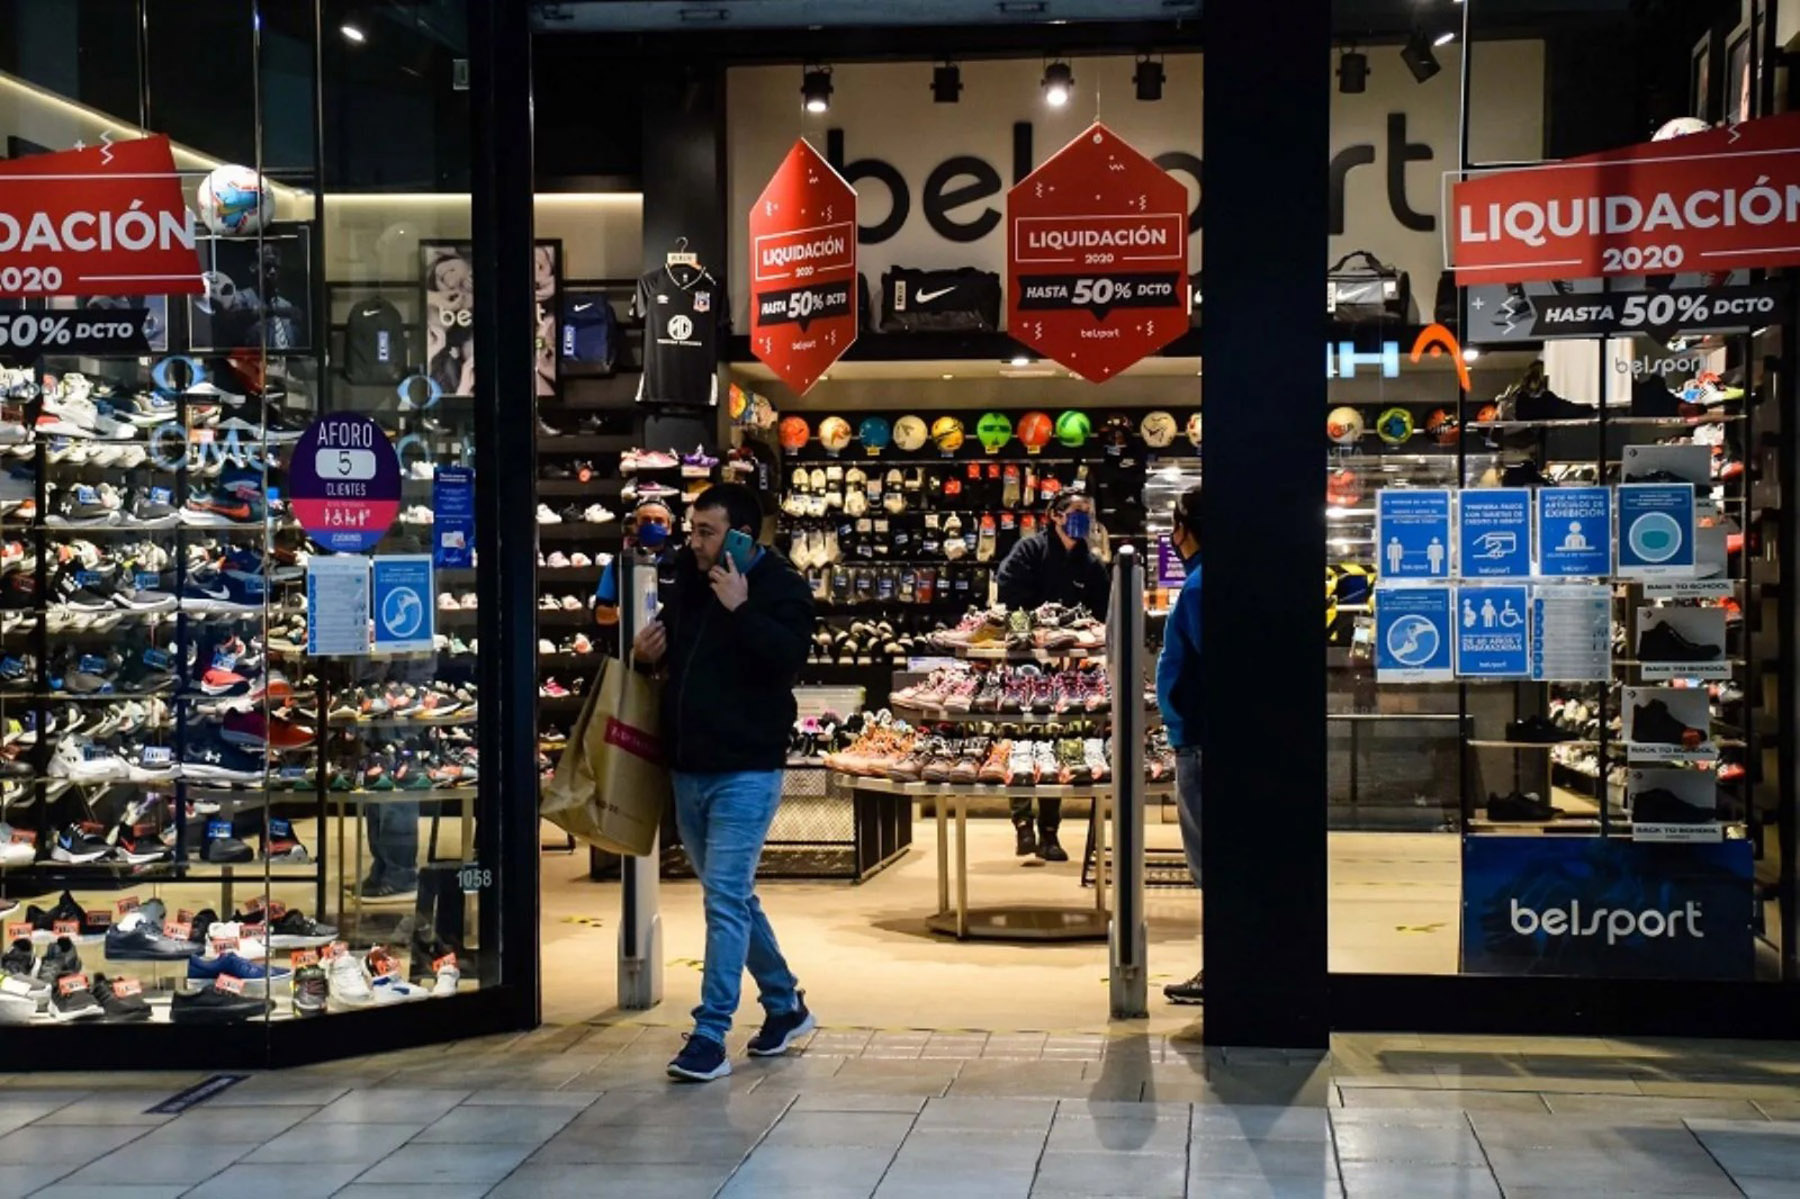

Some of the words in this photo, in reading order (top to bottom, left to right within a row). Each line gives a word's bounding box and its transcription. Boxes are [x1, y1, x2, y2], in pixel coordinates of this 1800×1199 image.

[762, 234, 844, 267] LIQUIDACIÓN
[1028, 226, 1167, 251] LIQUIDACIÓN
[795, 265, 814, 277] 2020
[1085, 252, 1115, 265] 2020
[1602, 245, 1684, 272] 2020
[0, 266, 62, 291] 020
[1026, 285, 1069, 299] HASTA
[1071, 278, 1133, 305] 50%
[1137, 283, 1173, 297] DCTO
[761, 300, 787, 316] HASTA
[787, 290, 824, 320] 50%
[825, 291, 847, 307] DCTO
[1545, 305, 1614, 323] HASTA
[1619, 294, 1709, 327] 50%
[1712, 297, 1774, 315] DCTO
[74, 322, 134, 341] DCTO
[1080, 326, 1121, 340] belsport
[317, 421, 373, 448] AFORO
[338, 450, 353, 476] 5
[326, 482, 367, 497] CLIENTES
[456, 869, 492, 888] 1058
[1510, 898, 1704, 945] belsport
